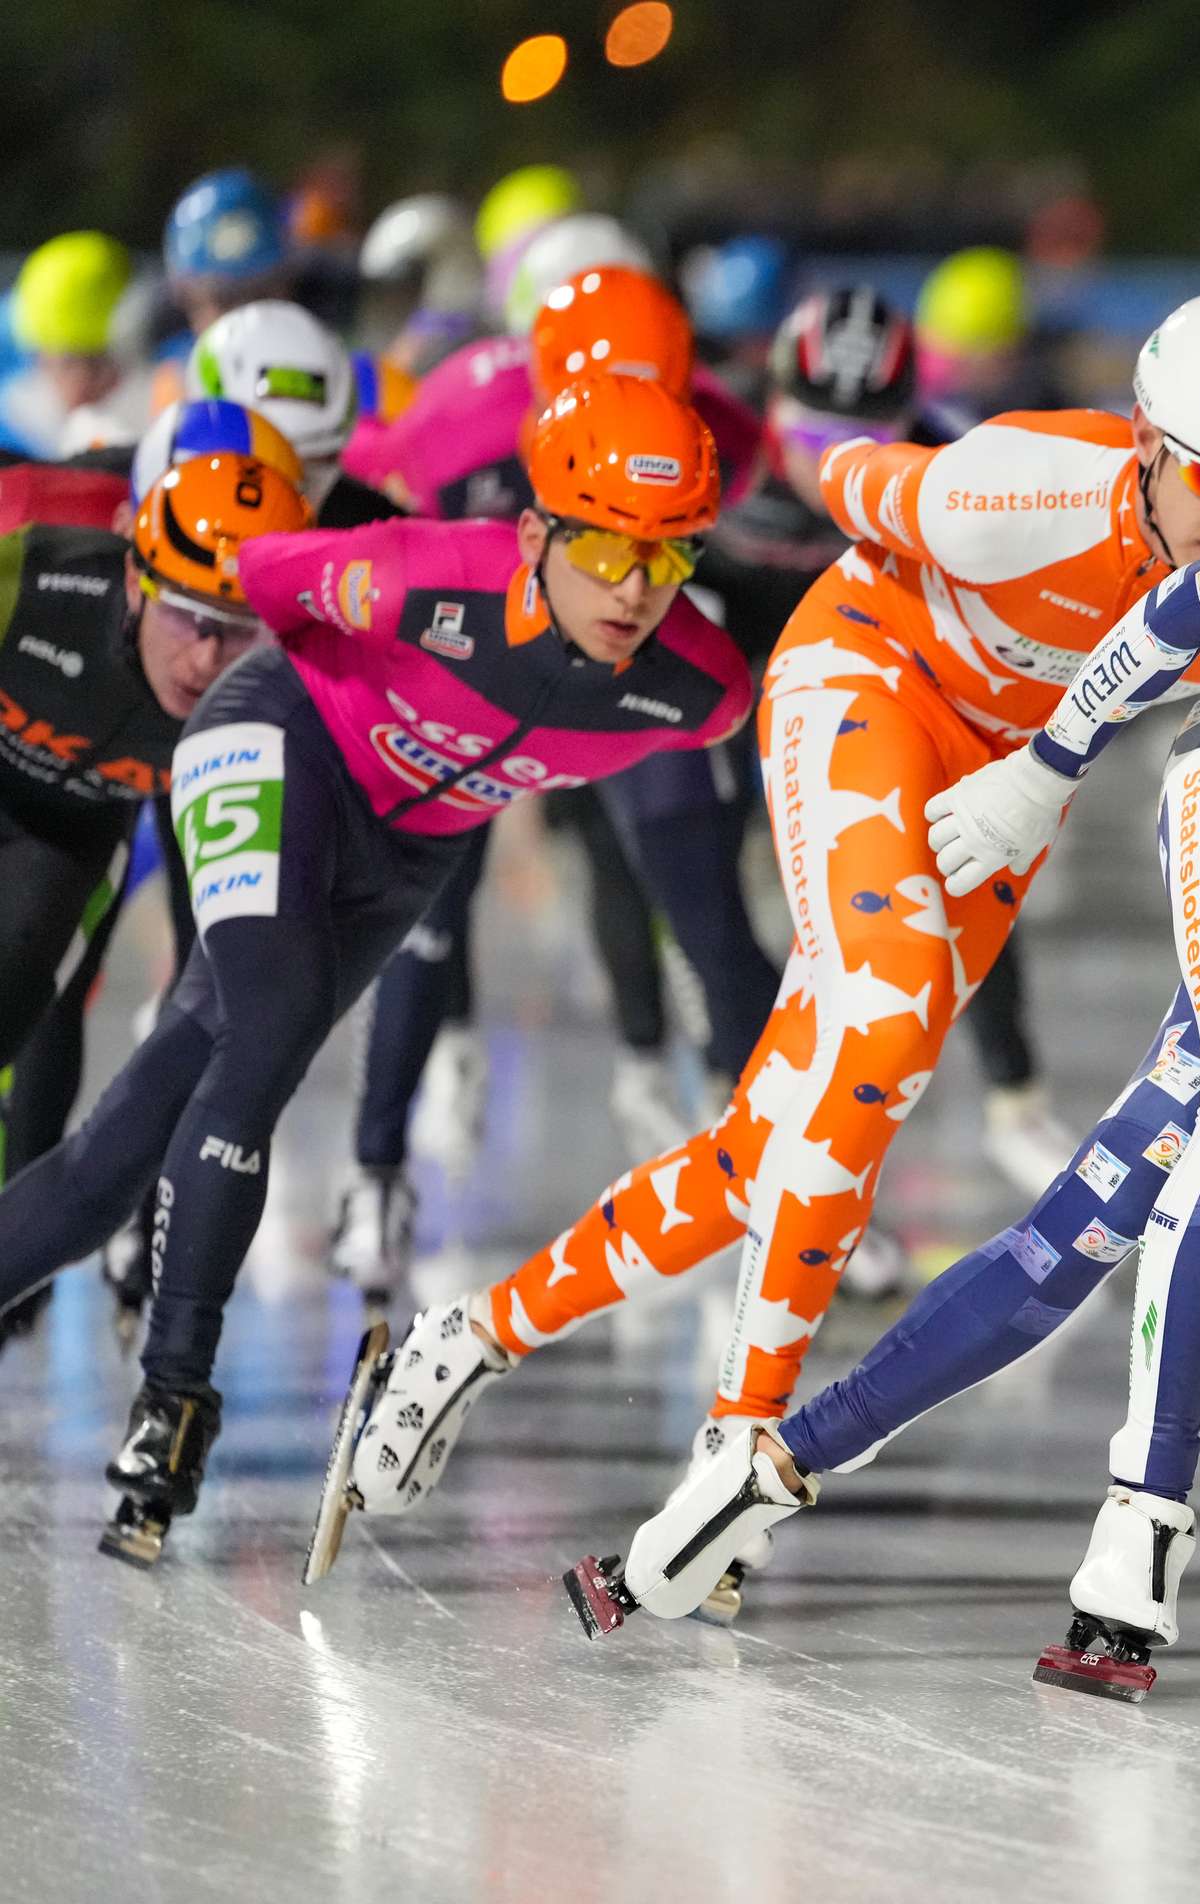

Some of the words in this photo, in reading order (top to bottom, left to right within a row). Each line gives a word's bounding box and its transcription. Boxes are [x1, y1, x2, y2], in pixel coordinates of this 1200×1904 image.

[945, 481, 1110, 511] Staatsloterij
[181, 750, 261, 789] DAIKIN
[199, 1135, 260, 1175] FILA
[1149, 1208, 1179, 1232] ORTE
